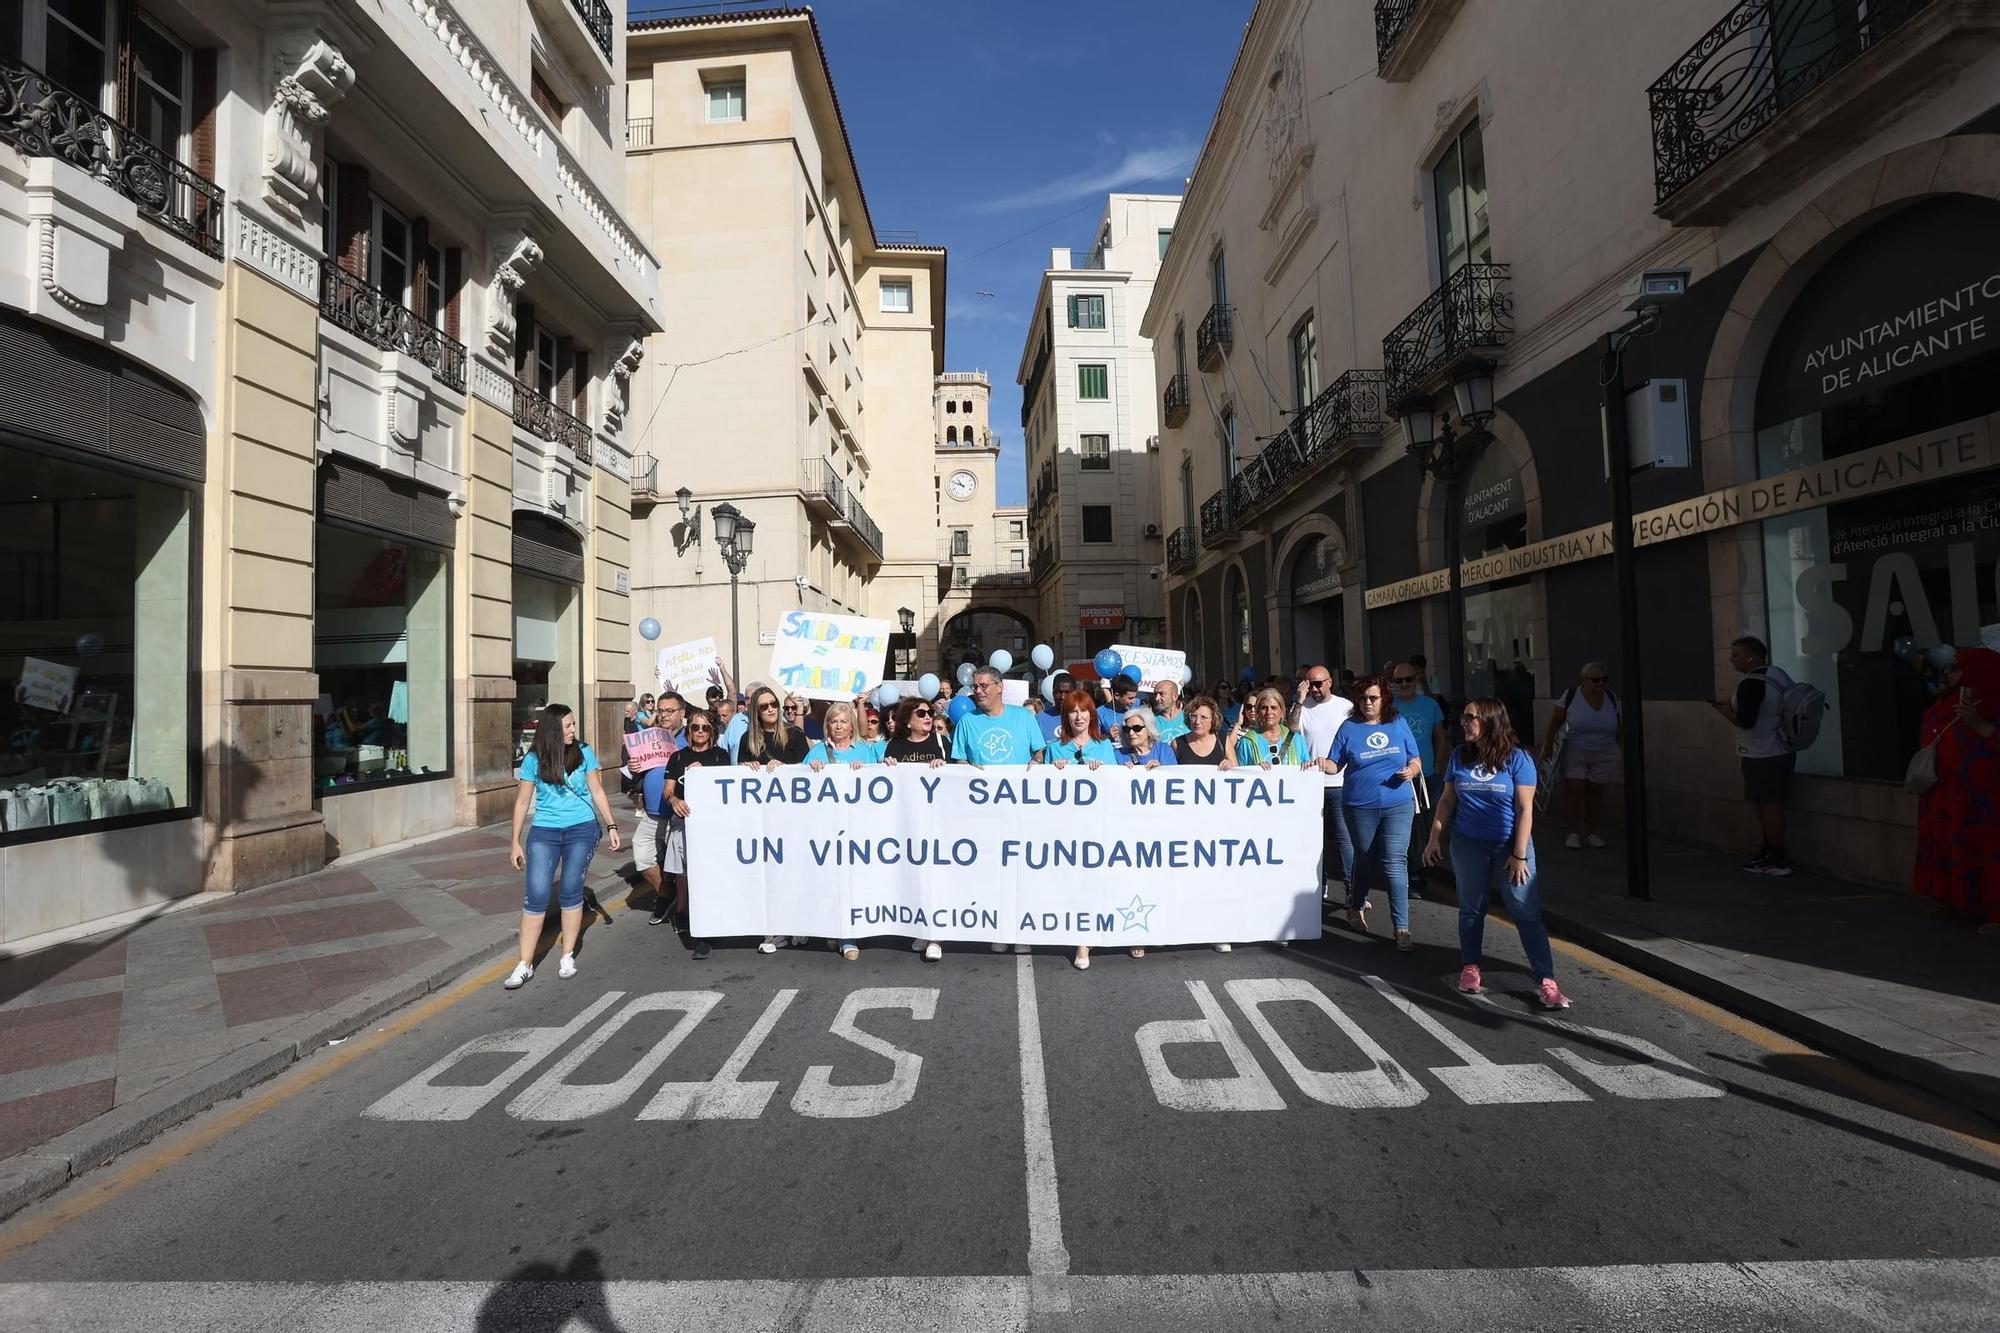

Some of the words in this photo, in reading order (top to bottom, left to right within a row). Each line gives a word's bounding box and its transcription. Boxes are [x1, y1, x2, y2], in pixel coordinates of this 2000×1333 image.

[1804, 274, 2000, 373] AYUNTAMIENTO
[1822, 367, 1851, 394] DE
[1856, 315, 1986, 383] ALICANTE
[1464, 478, 1512, 510] AJUNTAMENT
[1399, 579, 1430, 598] OFICIAL
[1432, 574, 1445, 591] DE
[1509, 538, 1583, 572] INDUSTRIA
[1586, 534, 1596, 552] Y
[1752, 483, 1786, 512] DE
[1795, 432, 1977, 502] ALICANTE
[1850, 518, 1900, 537] Atención
[1904, 507, 1953, 526] Integral
[1892, 525, 1944, 543] Integral
[1949, 524, 1958, 535] a
[1962, 519, 1975, 533] la
[782, 610, 839, 642] SALUD
[1080, 607, 1123, 618] SUPERMERCADO
[778, 662, 866, 694] TRABAJO
[652, 741, 662, 750] ES
[902, 752, 935, 762] Adiem
[715, 776, 894, 804] TRABAJO
[920, 776, 941, 803] Y
[969, 778, 1098, 805] SALUD
[1131, 779, 1295, 808] MENTAL
[737, 837, 783, 865] UN
[810, 831, 978, 866] VÍNCULO
[1002, 838, 1284, 869] FUNDAMENTAL
[851, 902, 998, 930] FUNDACIÓN
[1020, 912, 1115, 932] ADIEM
[359, 987, 941, 1121] STOP
[1134, 975, 1728, 1112] STOP
